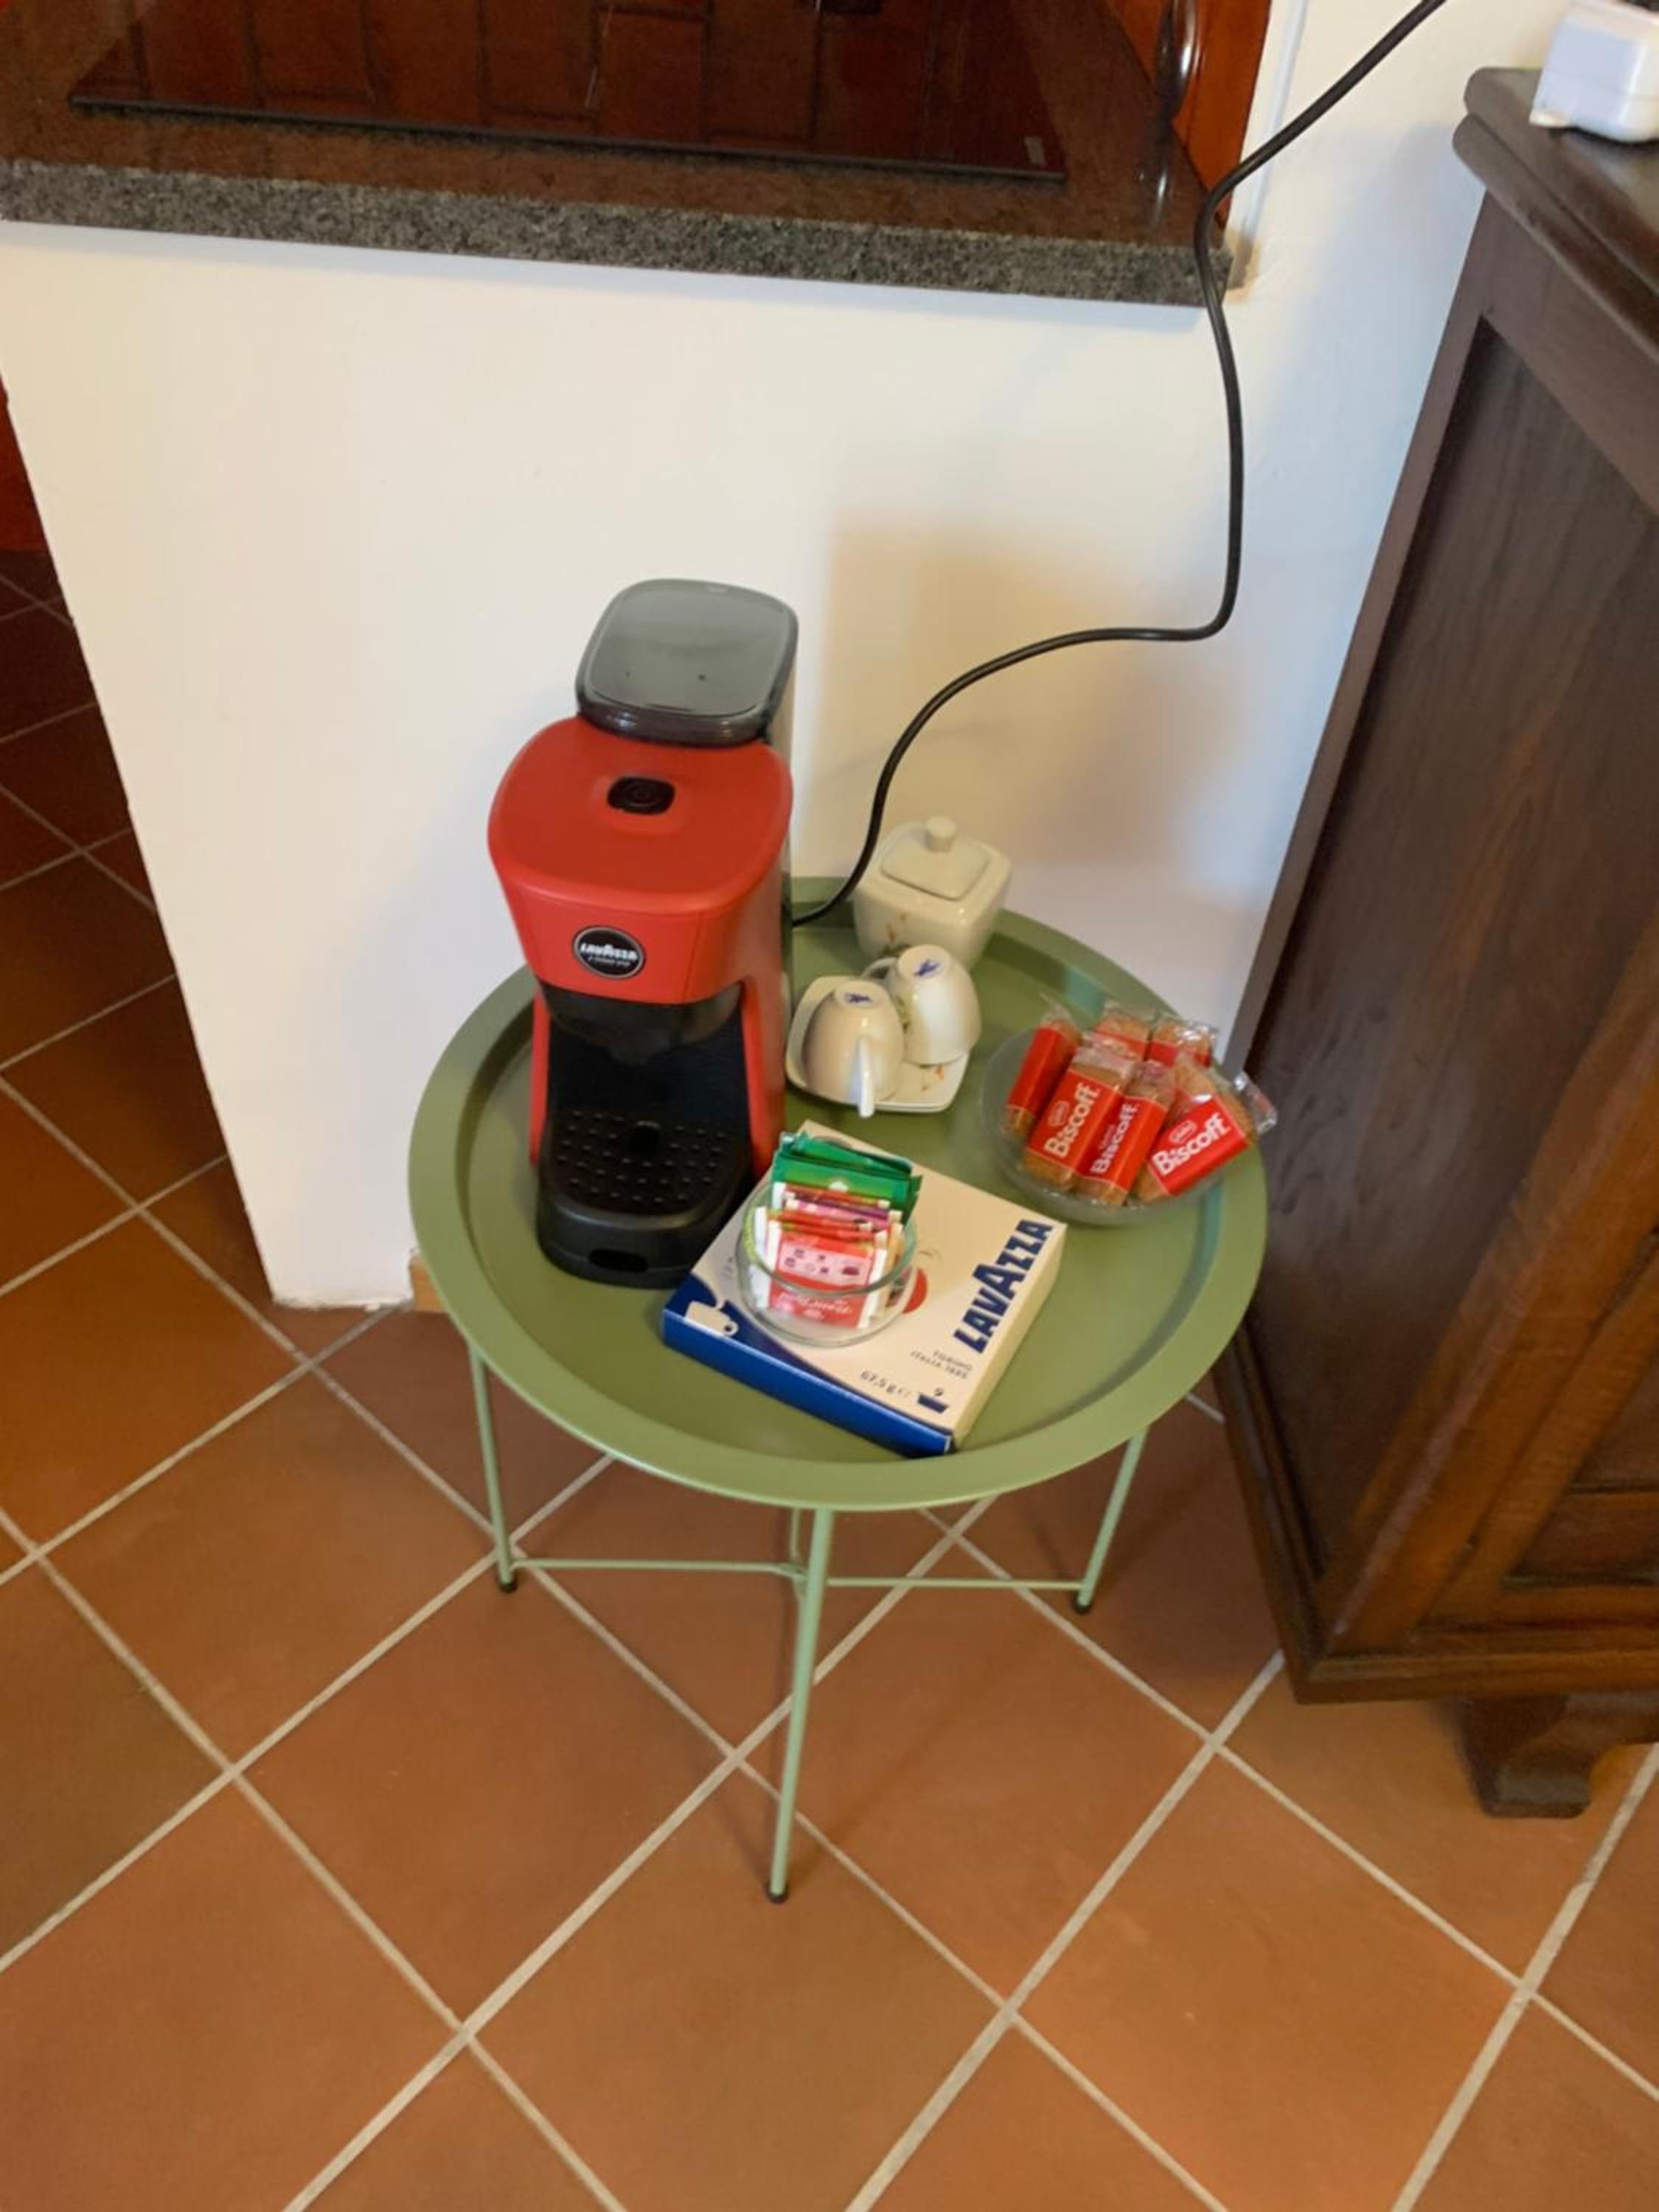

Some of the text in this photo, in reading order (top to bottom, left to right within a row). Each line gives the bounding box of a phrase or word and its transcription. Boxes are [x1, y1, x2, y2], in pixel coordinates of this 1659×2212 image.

[1043, 1082, 1101, 1159] Biscoff
[1090, 1104, 1139, 1173] Biscoff
[1152, 1112, 1228, 1175] Biscoff
[953, 1219, 1053, 1354] LAVAZZA
